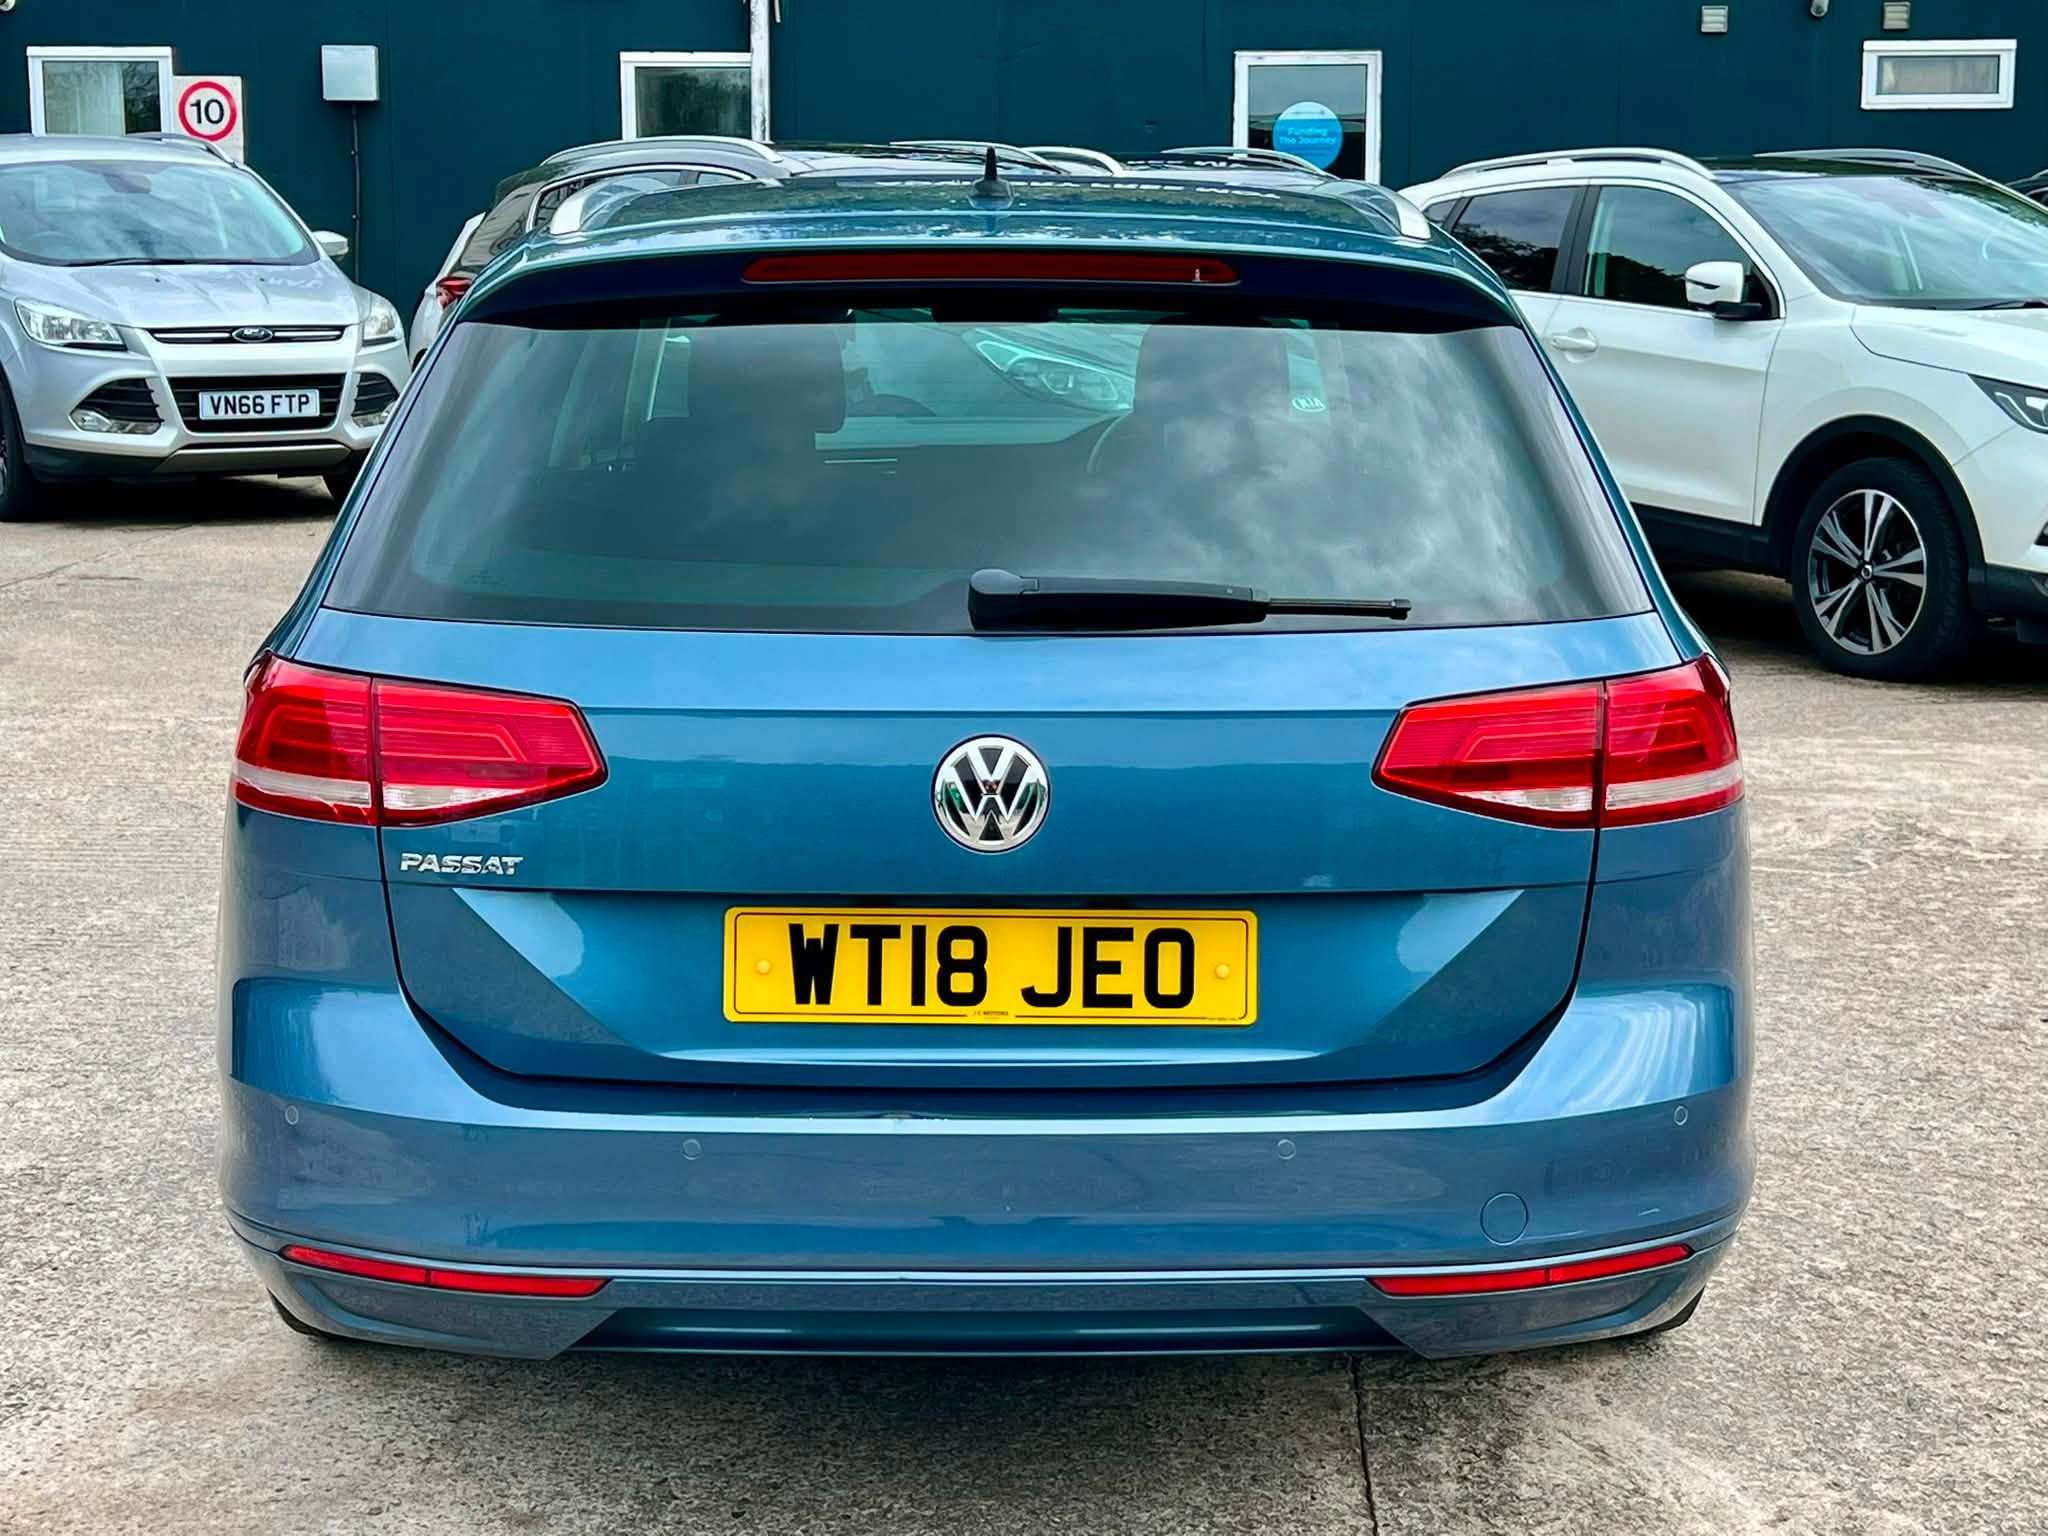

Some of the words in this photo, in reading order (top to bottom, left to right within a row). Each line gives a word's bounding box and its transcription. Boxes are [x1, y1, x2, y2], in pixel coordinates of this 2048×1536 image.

[190, 98, 224, 125] 10
[210, 395, 265, 415] VN66
[271, 394, 310, 414] FTP
[400, 852, 523, 875] PASSAT
[788, 922, 988, 1008] WT18
[1020, 925, 1195, 1010] JEO
